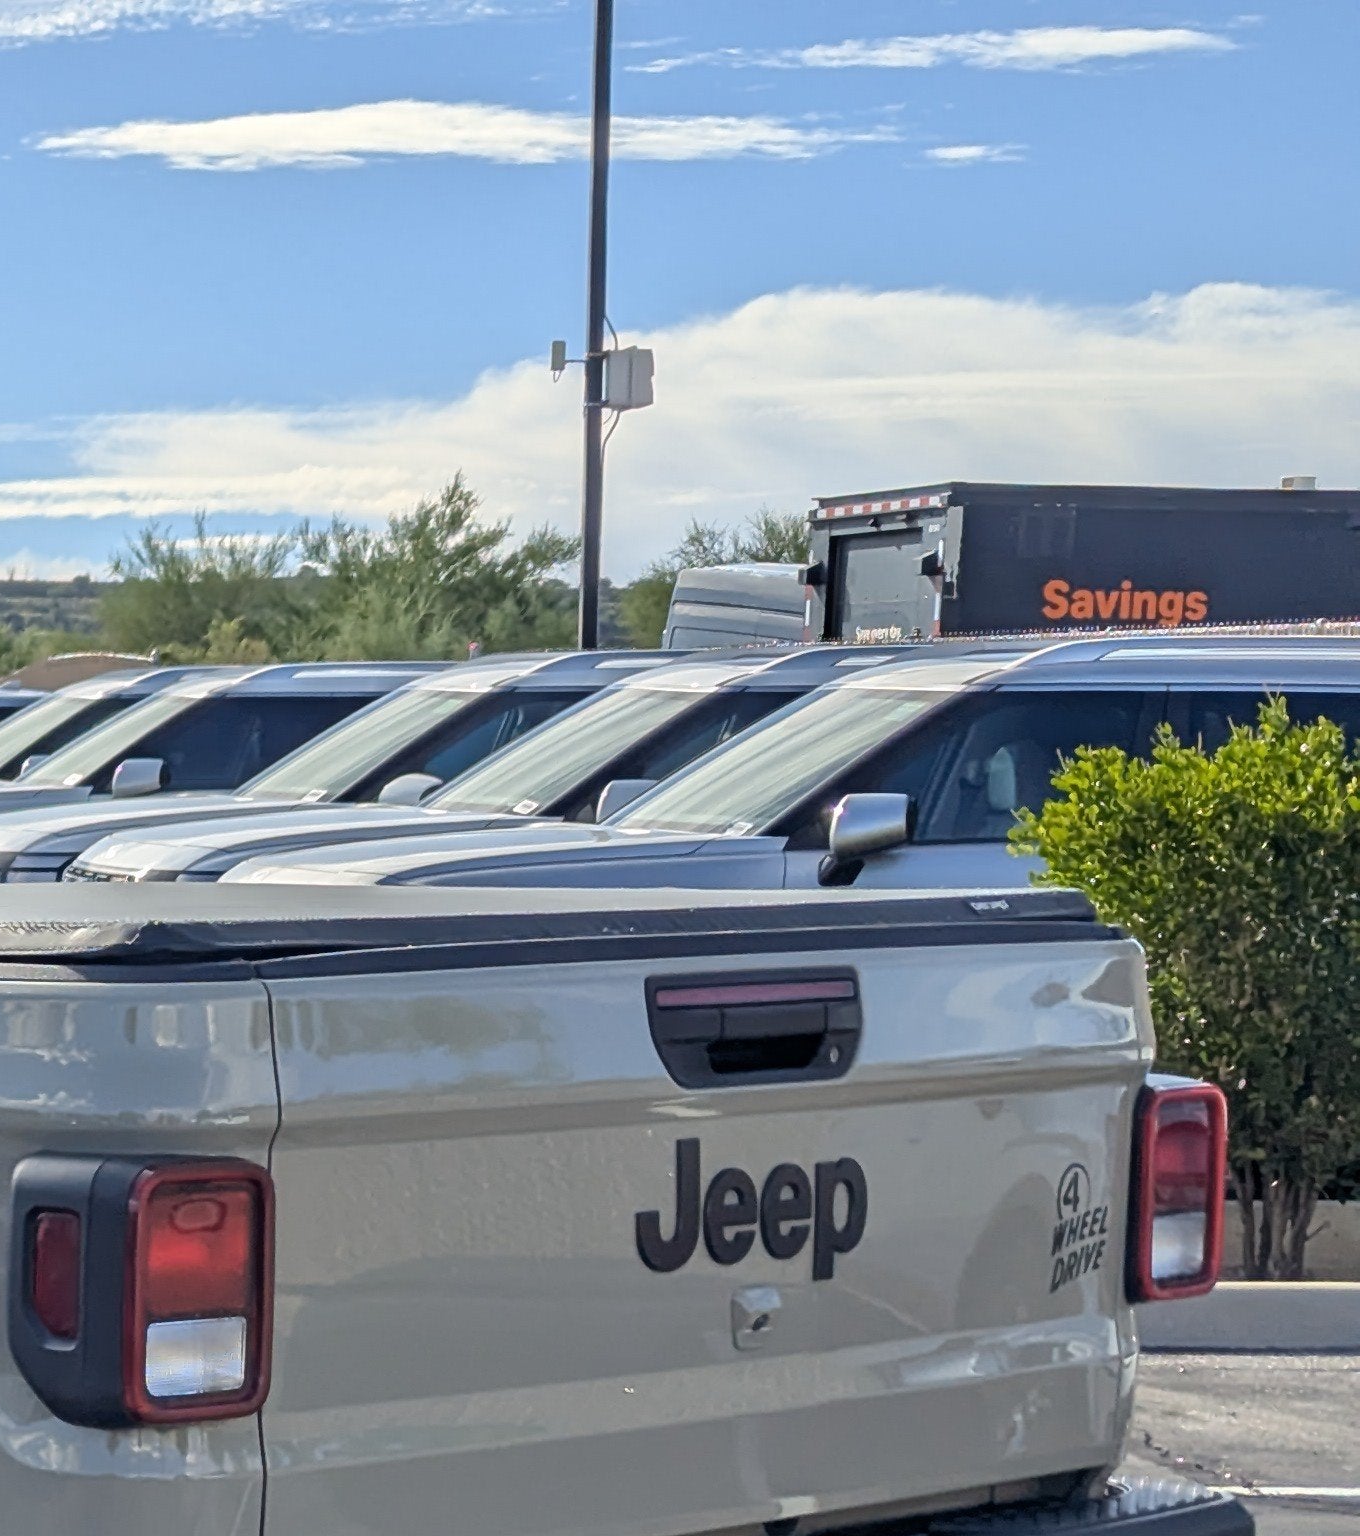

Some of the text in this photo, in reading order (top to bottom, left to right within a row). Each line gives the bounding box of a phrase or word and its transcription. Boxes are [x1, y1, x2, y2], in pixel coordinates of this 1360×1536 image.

[1042, 579, 1209, 627] Savings
[635, 1137, 868, 1281] Jeep
[1051, 1205, 1108, 1257] WHEEL
[1049, 1240, 1106, 1293] DRIVE
